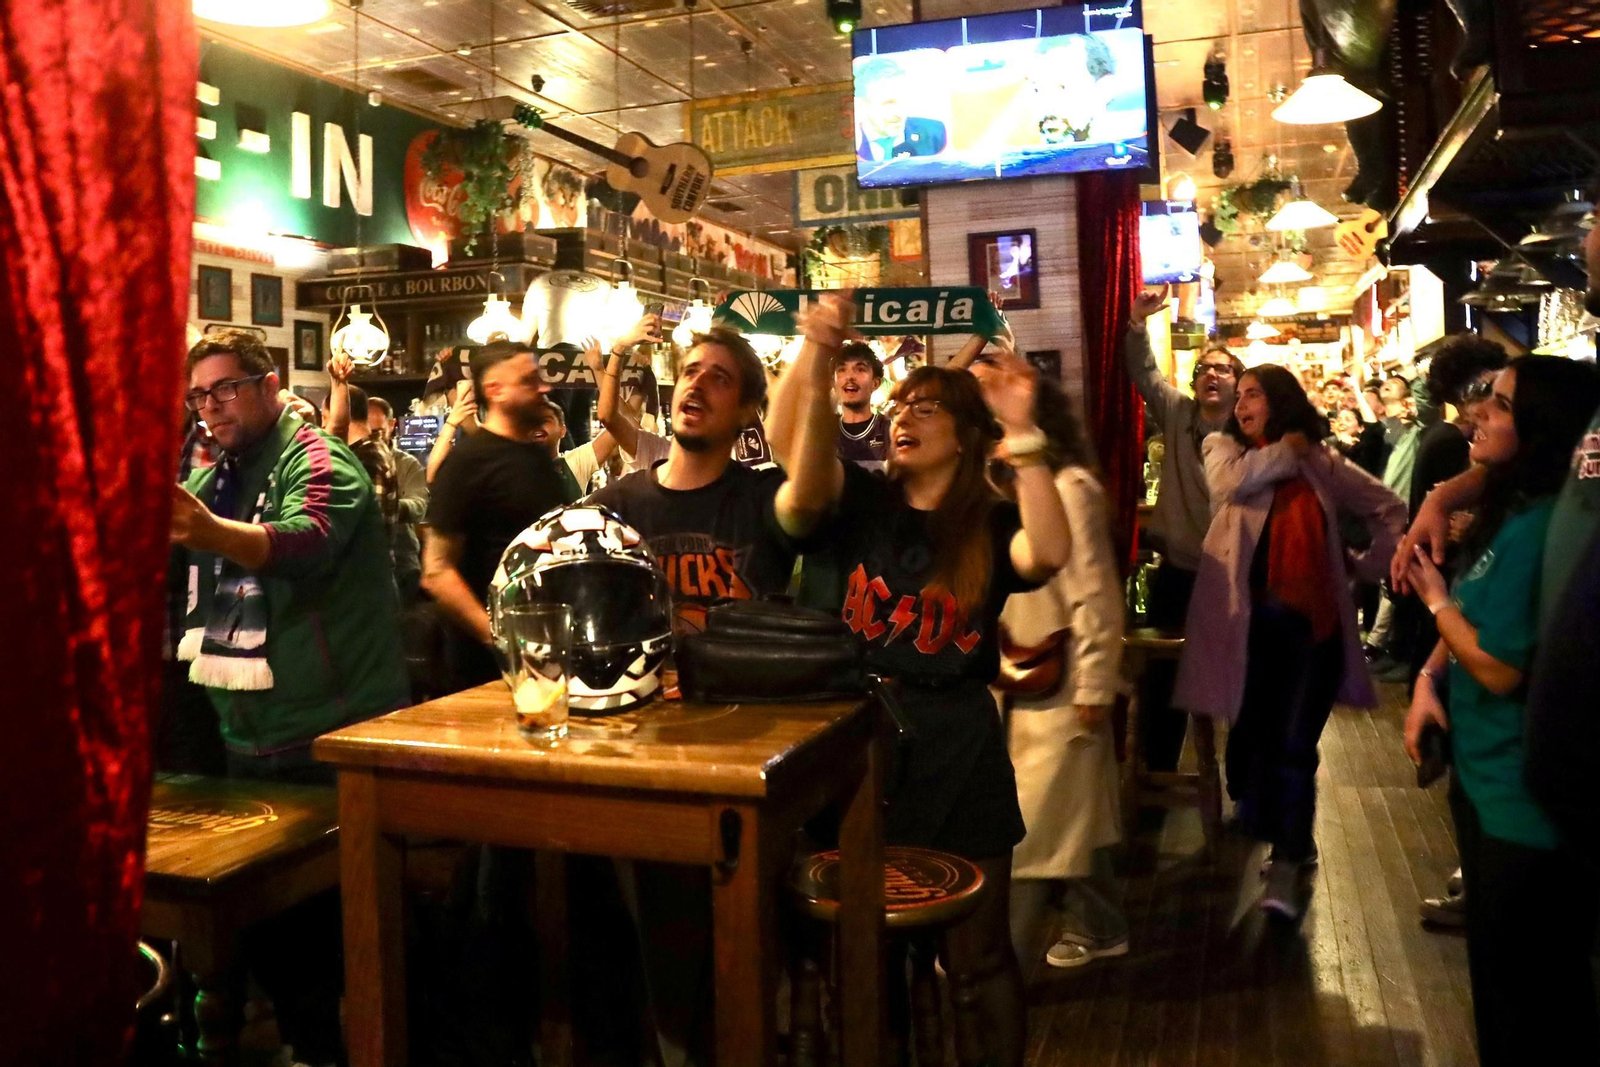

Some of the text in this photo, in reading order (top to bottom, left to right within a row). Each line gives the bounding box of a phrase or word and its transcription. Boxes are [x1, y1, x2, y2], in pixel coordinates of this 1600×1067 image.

[701, 105, 793, 153] ATTACK
[683, 171, 705, 212] COMFORT
[392, 286, 401, 296] &
[406, 273, 488, 295] BOURBON
[656, 548, 752, 600] ICKS
